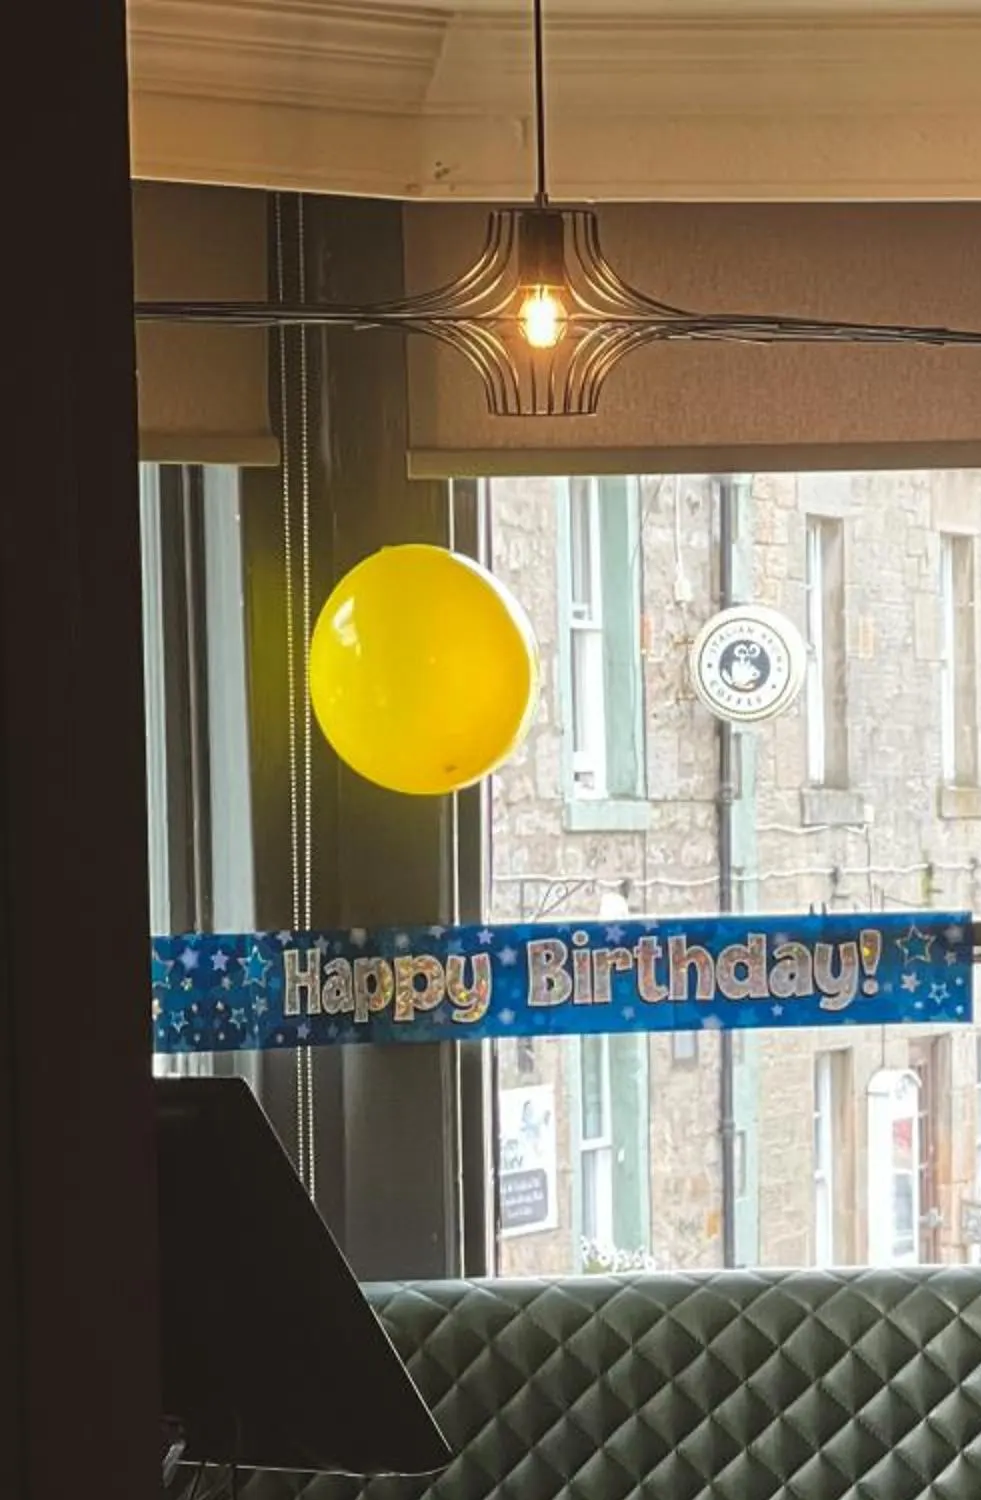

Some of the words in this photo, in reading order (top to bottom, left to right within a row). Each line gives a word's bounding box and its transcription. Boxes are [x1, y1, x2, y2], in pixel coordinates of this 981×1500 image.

[761, 633, 783, 673] ARMA
[283, 947, 493, 1023] Happy
[527, 929, 882, 1011] Birthday!
